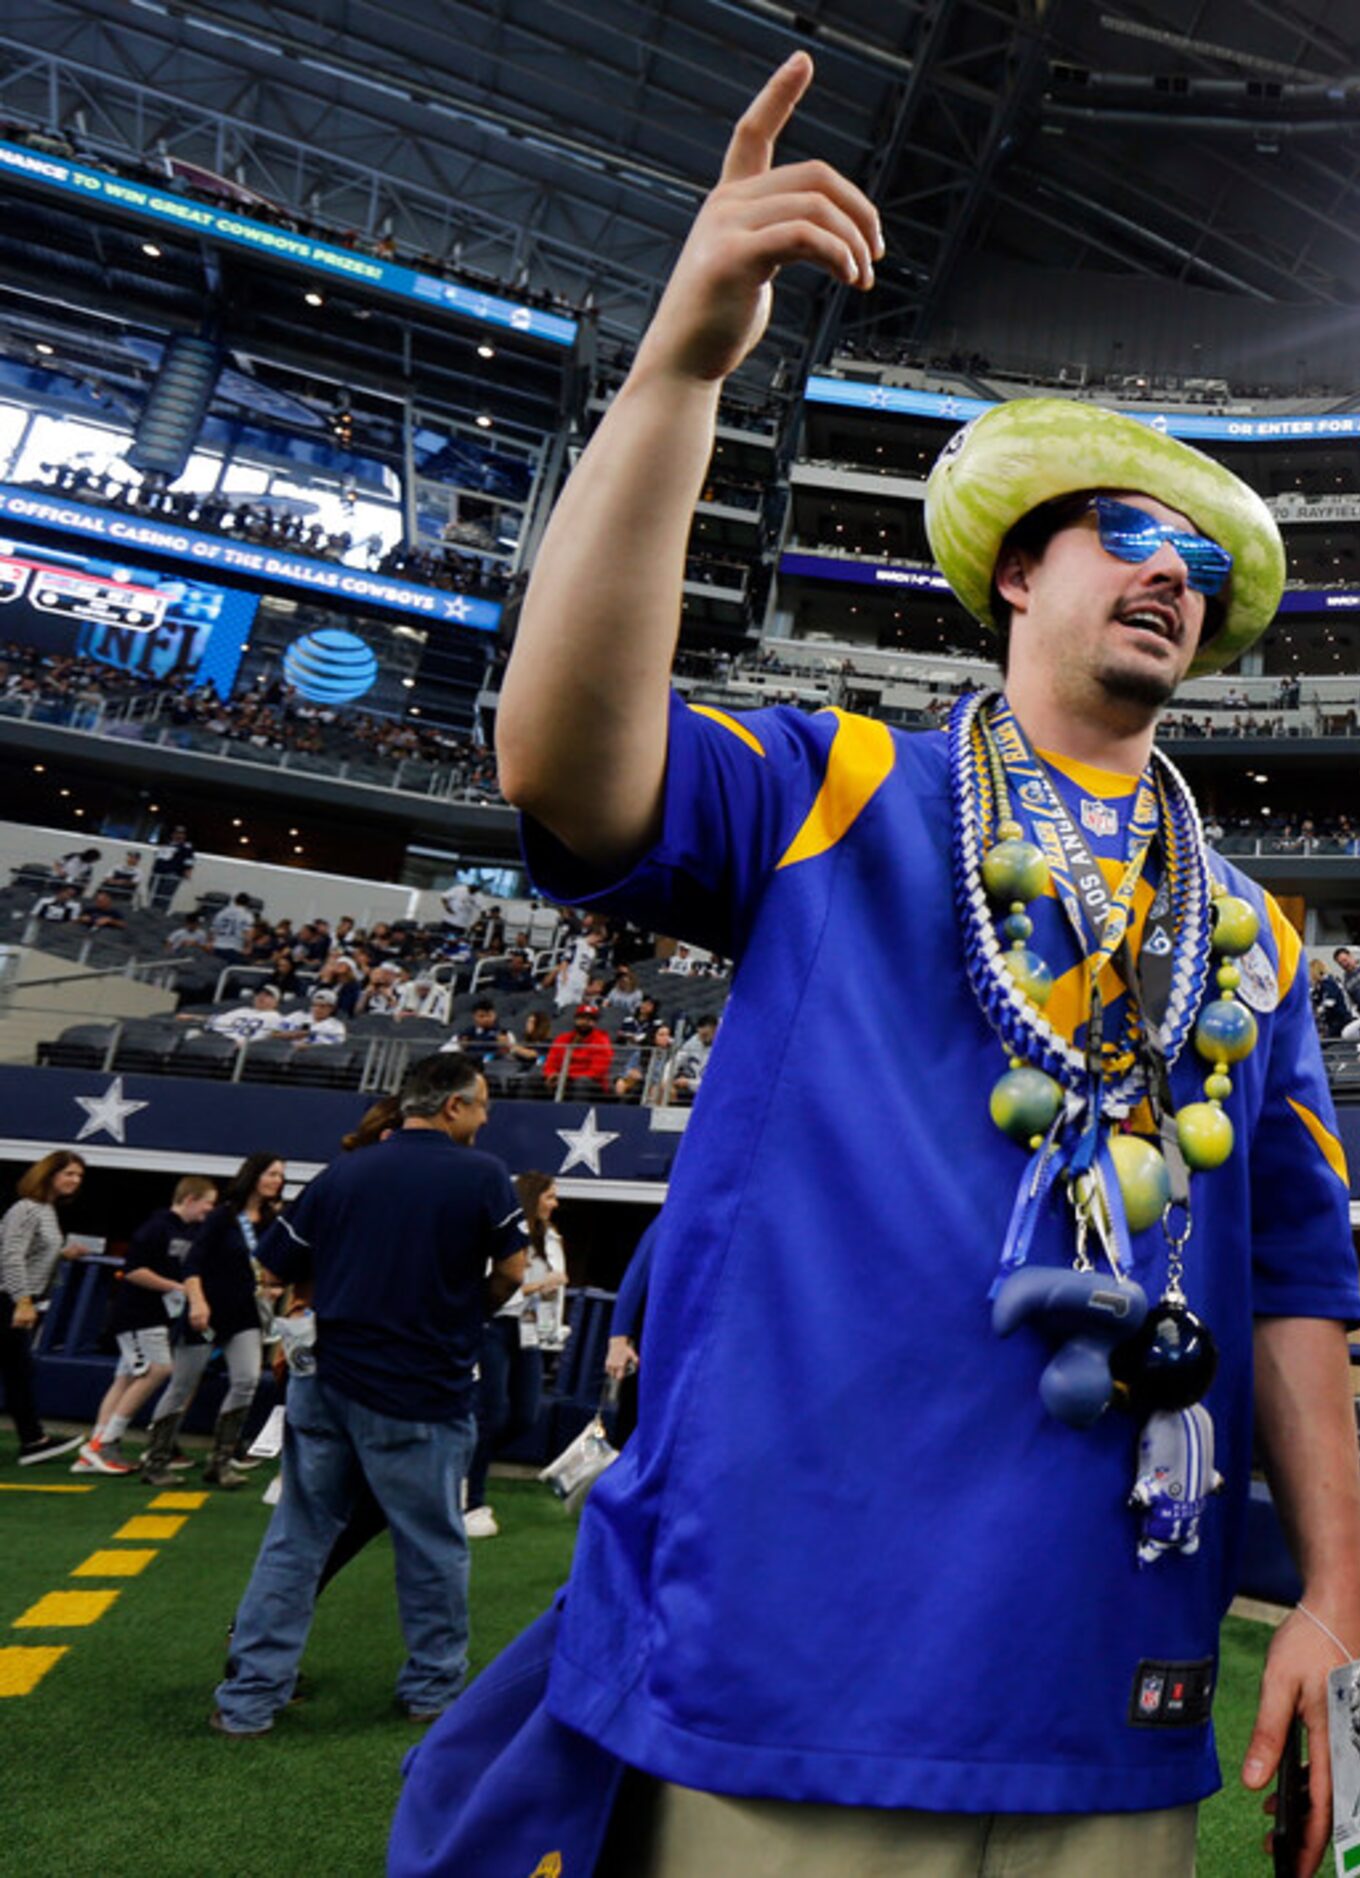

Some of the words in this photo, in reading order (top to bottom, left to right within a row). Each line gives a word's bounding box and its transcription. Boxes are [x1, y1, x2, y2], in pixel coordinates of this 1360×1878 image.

[73, 172, 101, 190] TO
[104, 182, 147, 205] WIN
[149, 198, 213, 226] GREAT
[216, 218, 310, 257] COWBOYS
[1229, 423, 1252, 435] OR
[1258, 421, 1313, 435] ENTER
[1318, 419, 1353, 433] FOR
[8, 498, 105, 533] OFFICIAL
[109, 521, 189, 552] CASINO
[192, 540, 221, 559] OF
[224, 548, 263, 570] THE
[265, 558, 338, 588] DALLAS
[340, 576, 435, 611] COWBOYS
[1080, 873, 1113, 925] LOS
